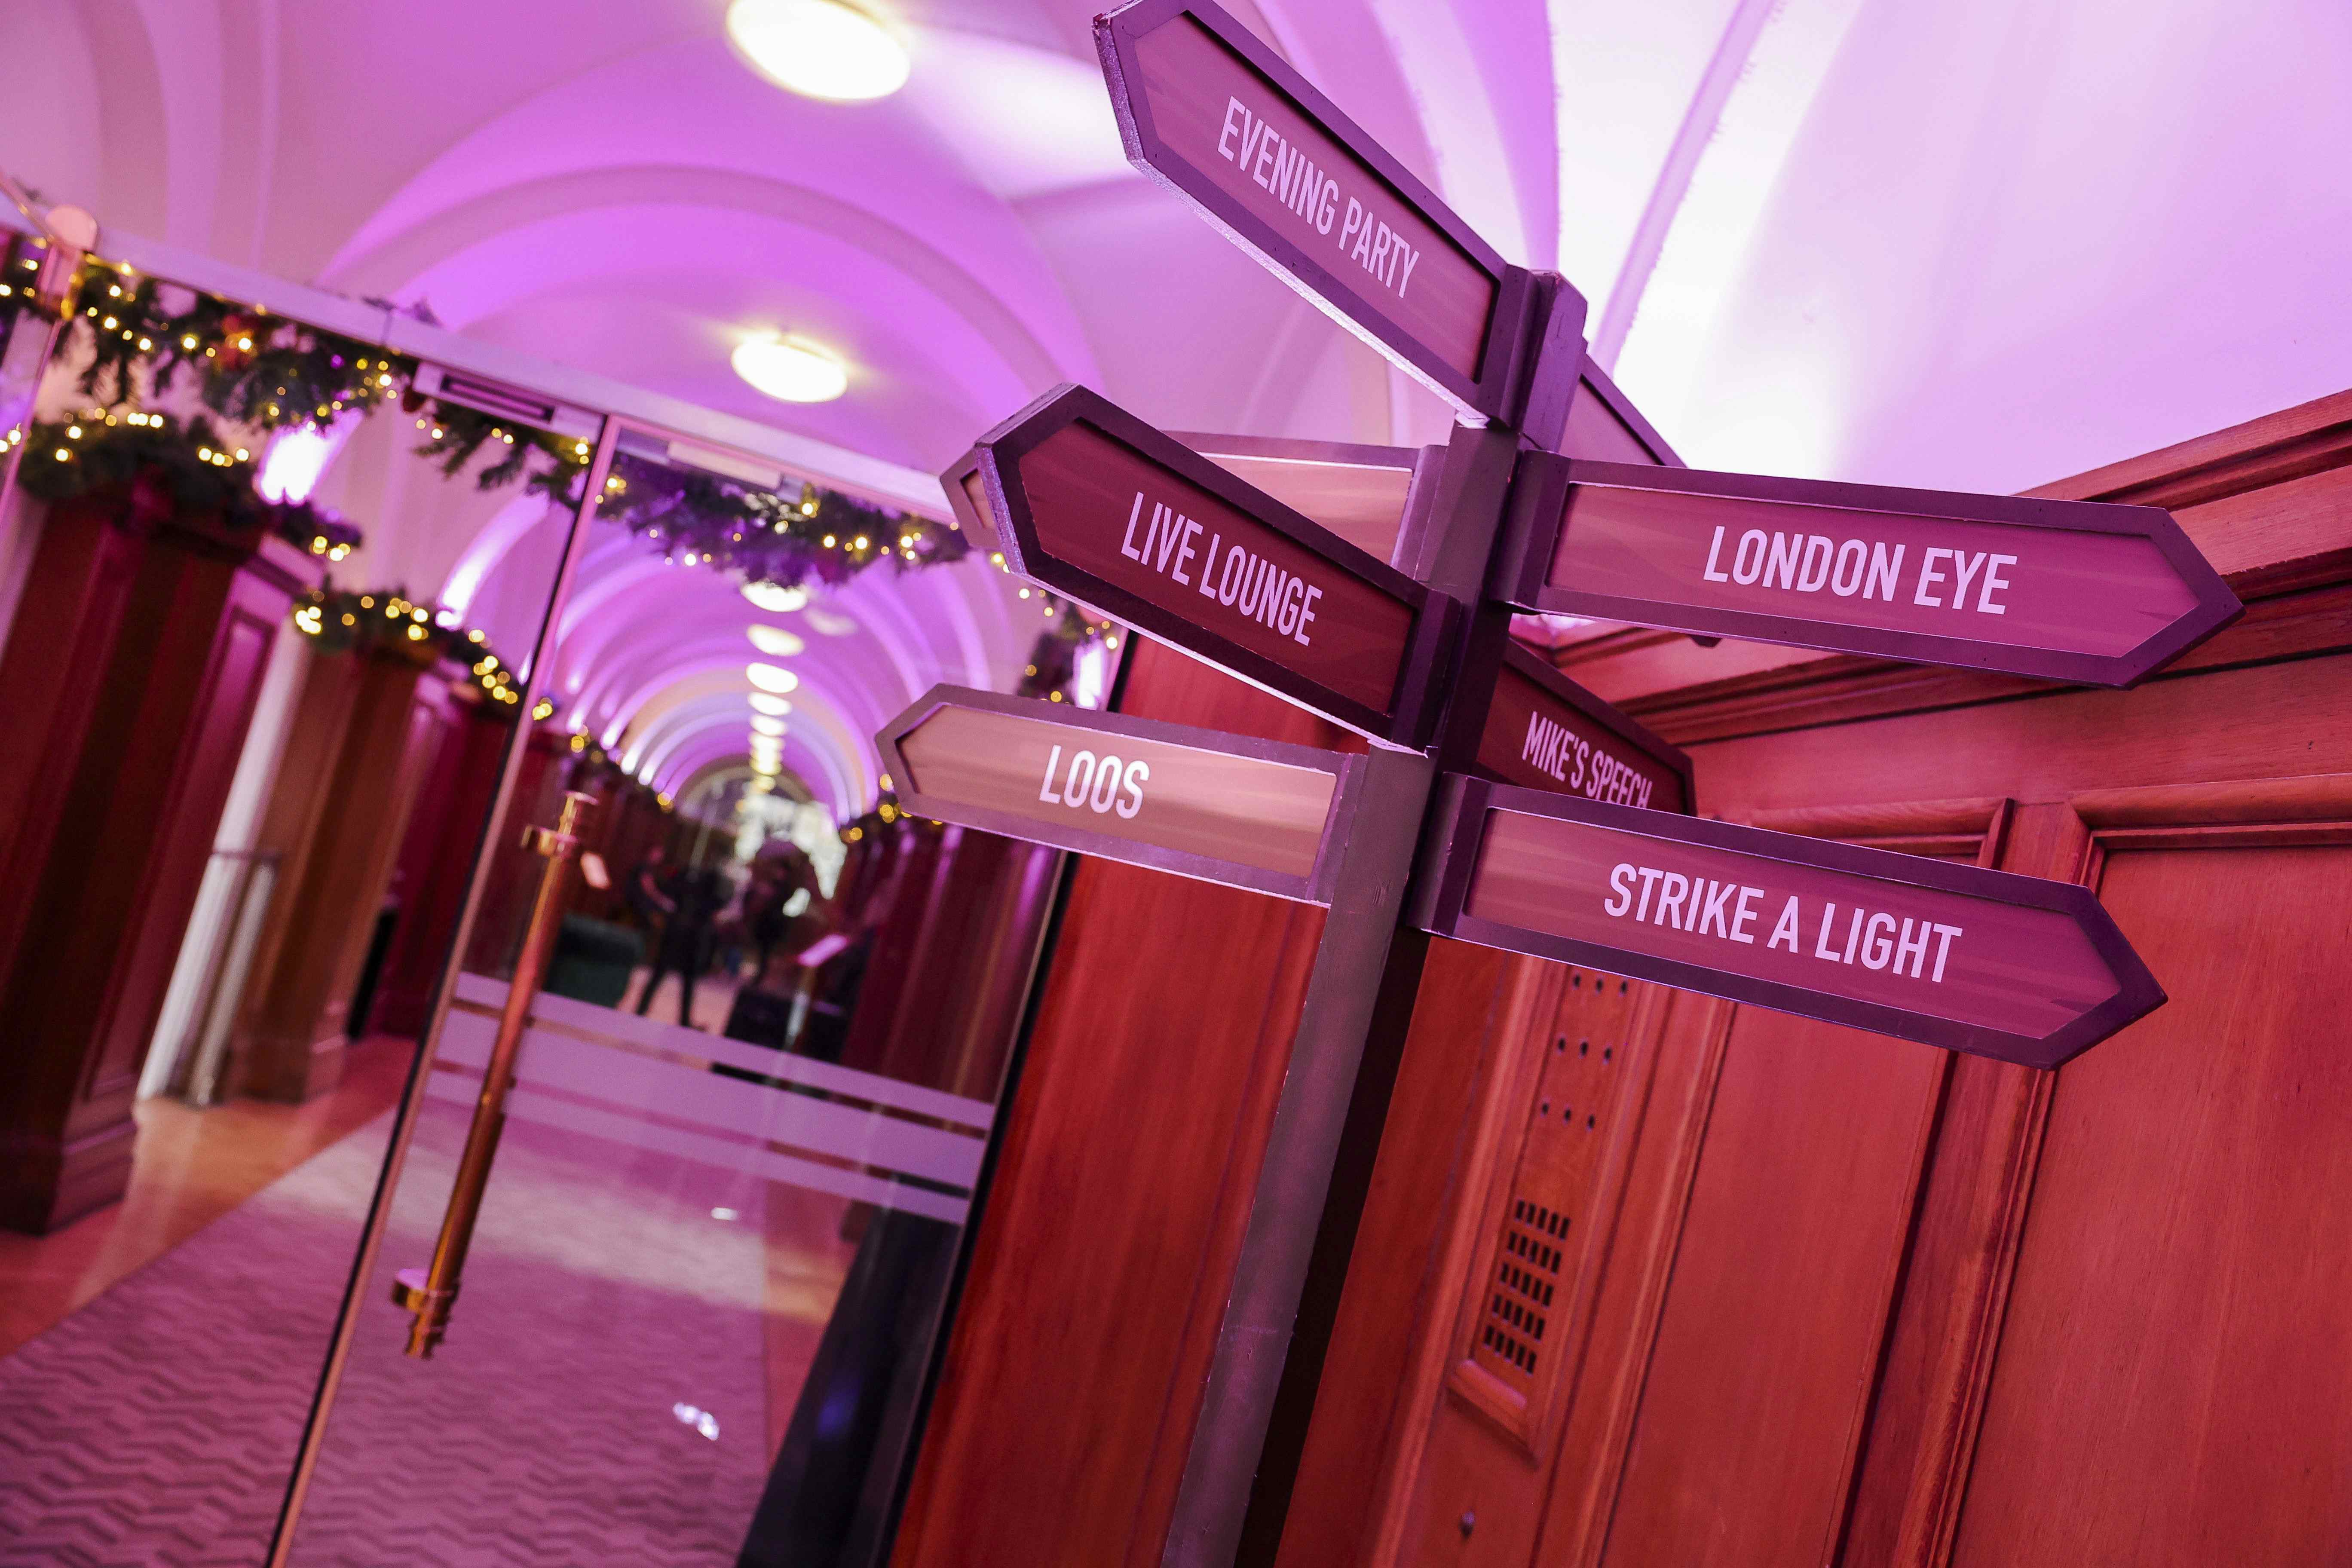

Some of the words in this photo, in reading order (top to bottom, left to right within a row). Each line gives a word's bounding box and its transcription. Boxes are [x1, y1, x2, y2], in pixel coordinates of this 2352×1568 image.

[1218, 96, 1338, 235] EVENING
[1338, 196, 1420, 298] PARTY
[1121, 492, 1203, 585] LIVE
[1199, 533, 1322, 646] LOUNGE
[1703, 526, 1905, 601] LONDON
[1914, 548, 2017, 614] EYE
[1040, 745, 1150, 818] LOOS
[1522, 710, 1589, 789] MIKE'S
[1605, 864, 1764, 943] STRIKE
[1767, 896, 1798, 953] A
[1815, 903, 1963, 983] LIGHT
